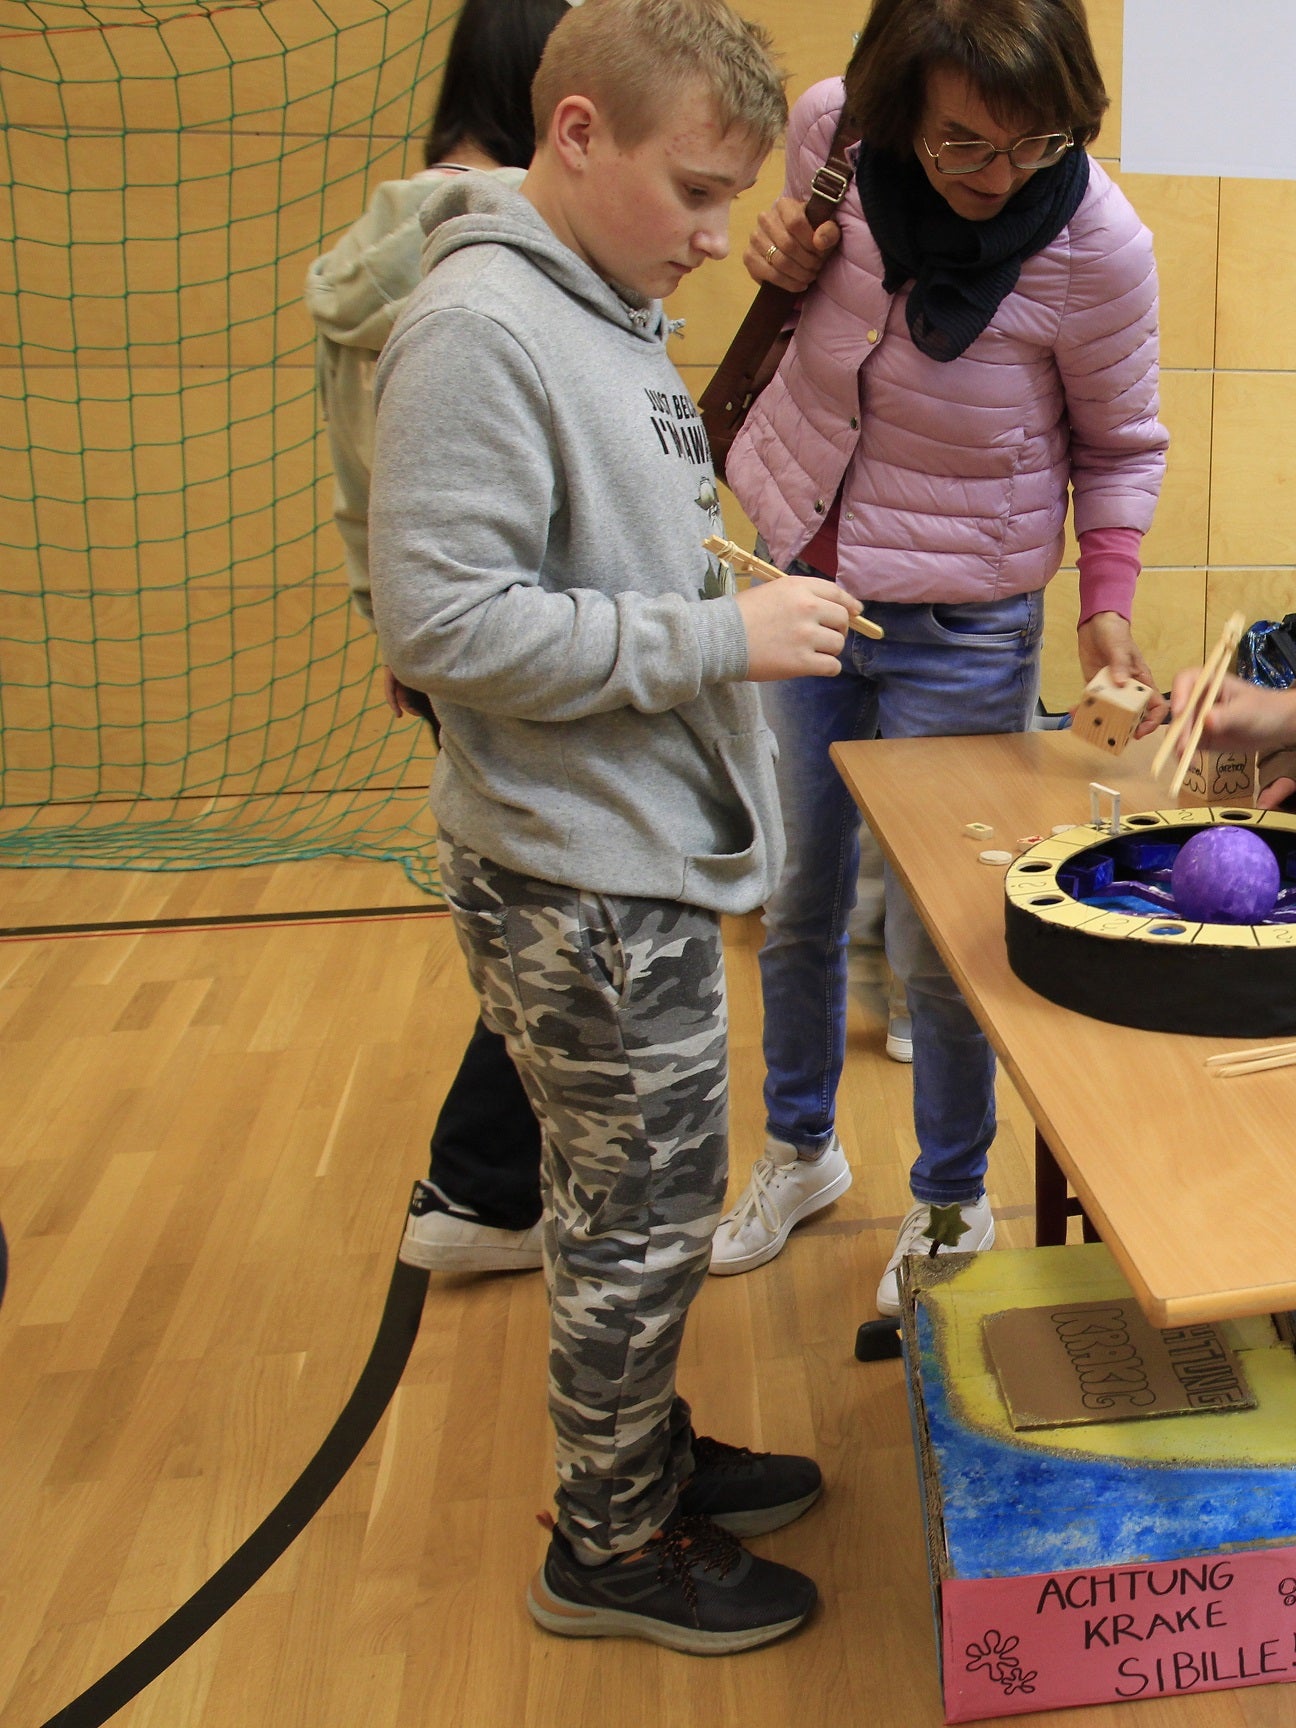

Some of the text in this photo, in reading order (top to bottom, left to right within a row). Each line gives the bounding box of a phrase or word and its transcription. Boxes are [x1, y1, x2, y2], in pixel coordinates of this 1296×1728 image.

[644, 388, 672, 416] JUST
[650, 416, 688, 460] I'M
[1160, 1323, 1243, 1408] HTUNG
[1036, 1561, 1234, 1614] ACHTUNG
[1083, 1600, 1228, 1649] KRAKE
